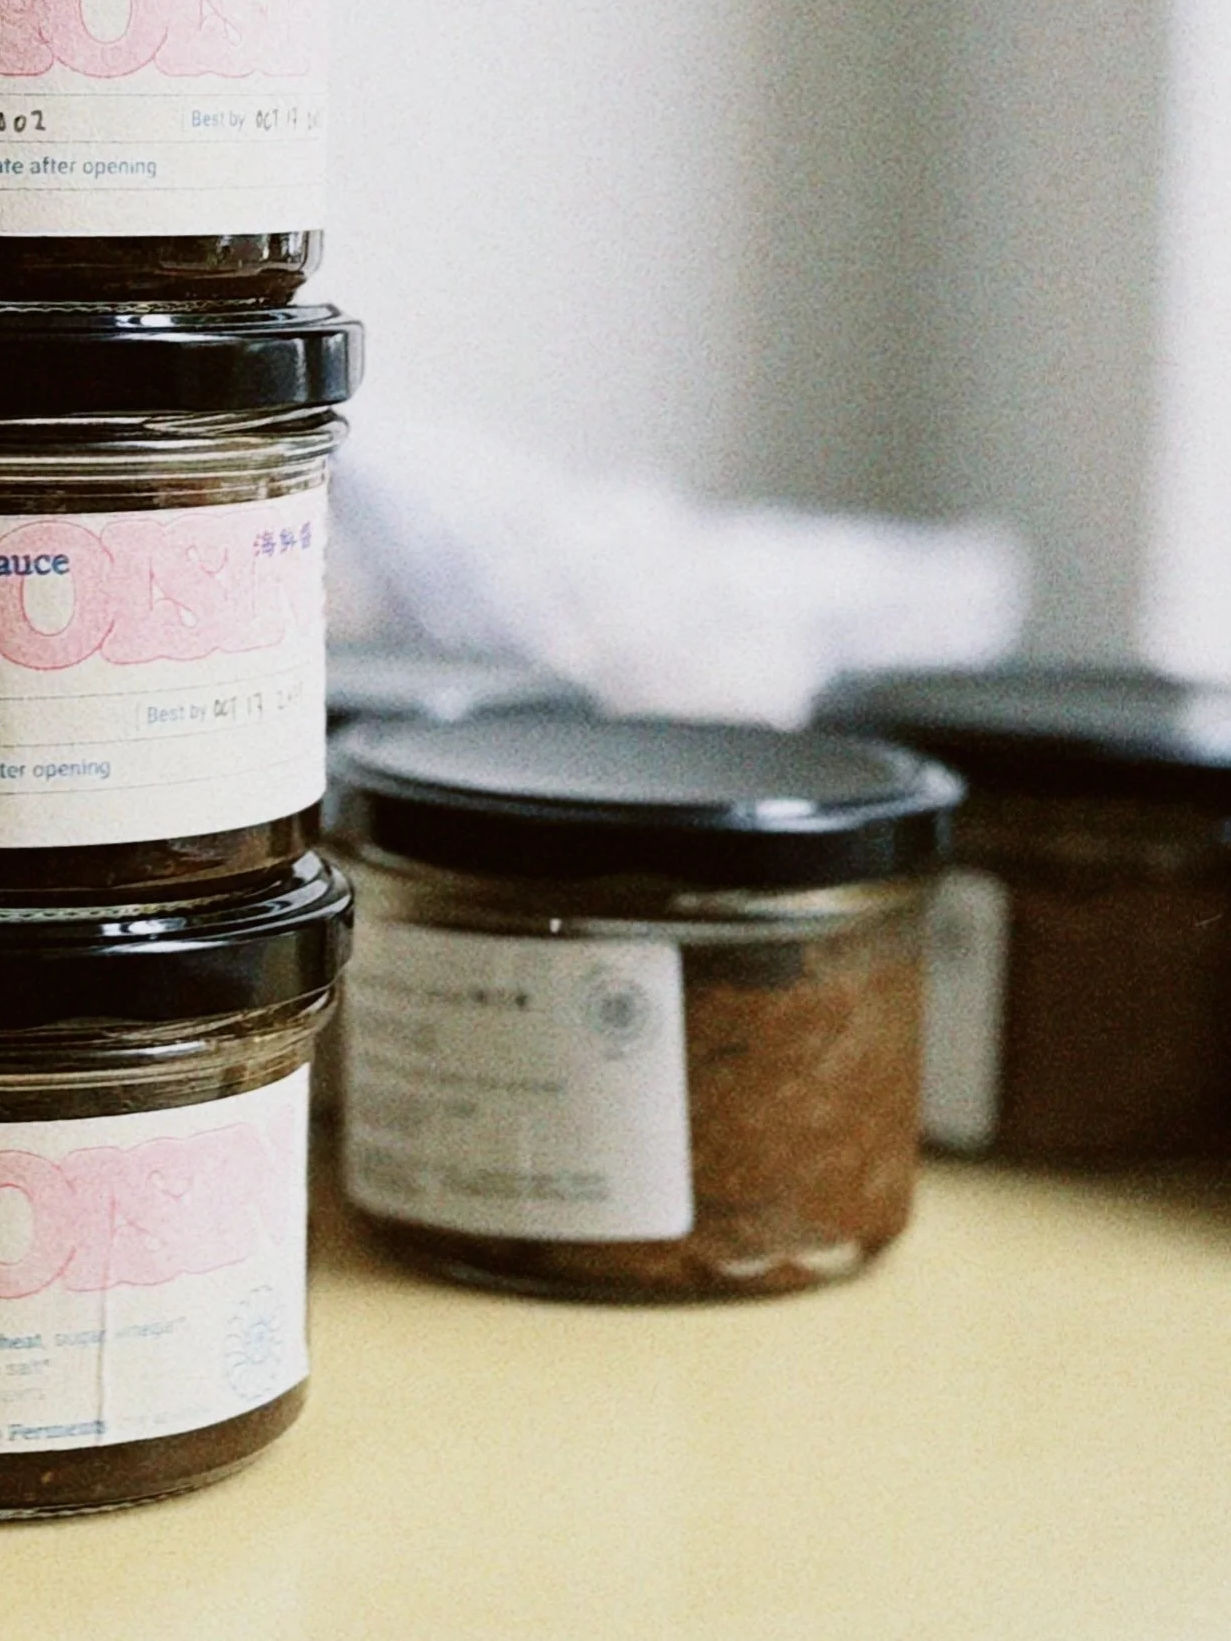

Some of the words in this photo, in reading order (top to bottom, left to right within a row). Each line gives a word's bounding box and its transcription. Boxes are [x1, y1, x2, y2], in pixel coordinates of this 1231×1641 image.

[191, 109, 224, 128] Best
[228, 110, 246, 132] by
[255, 107, 280, 132] OCT
[29, 158, 76, 177] after
[82, 162, 158, 180] opening
[147, 704, 185, 724] Best
[188, 703, 206, 724] by
[32, 759, 111, 780] opening
